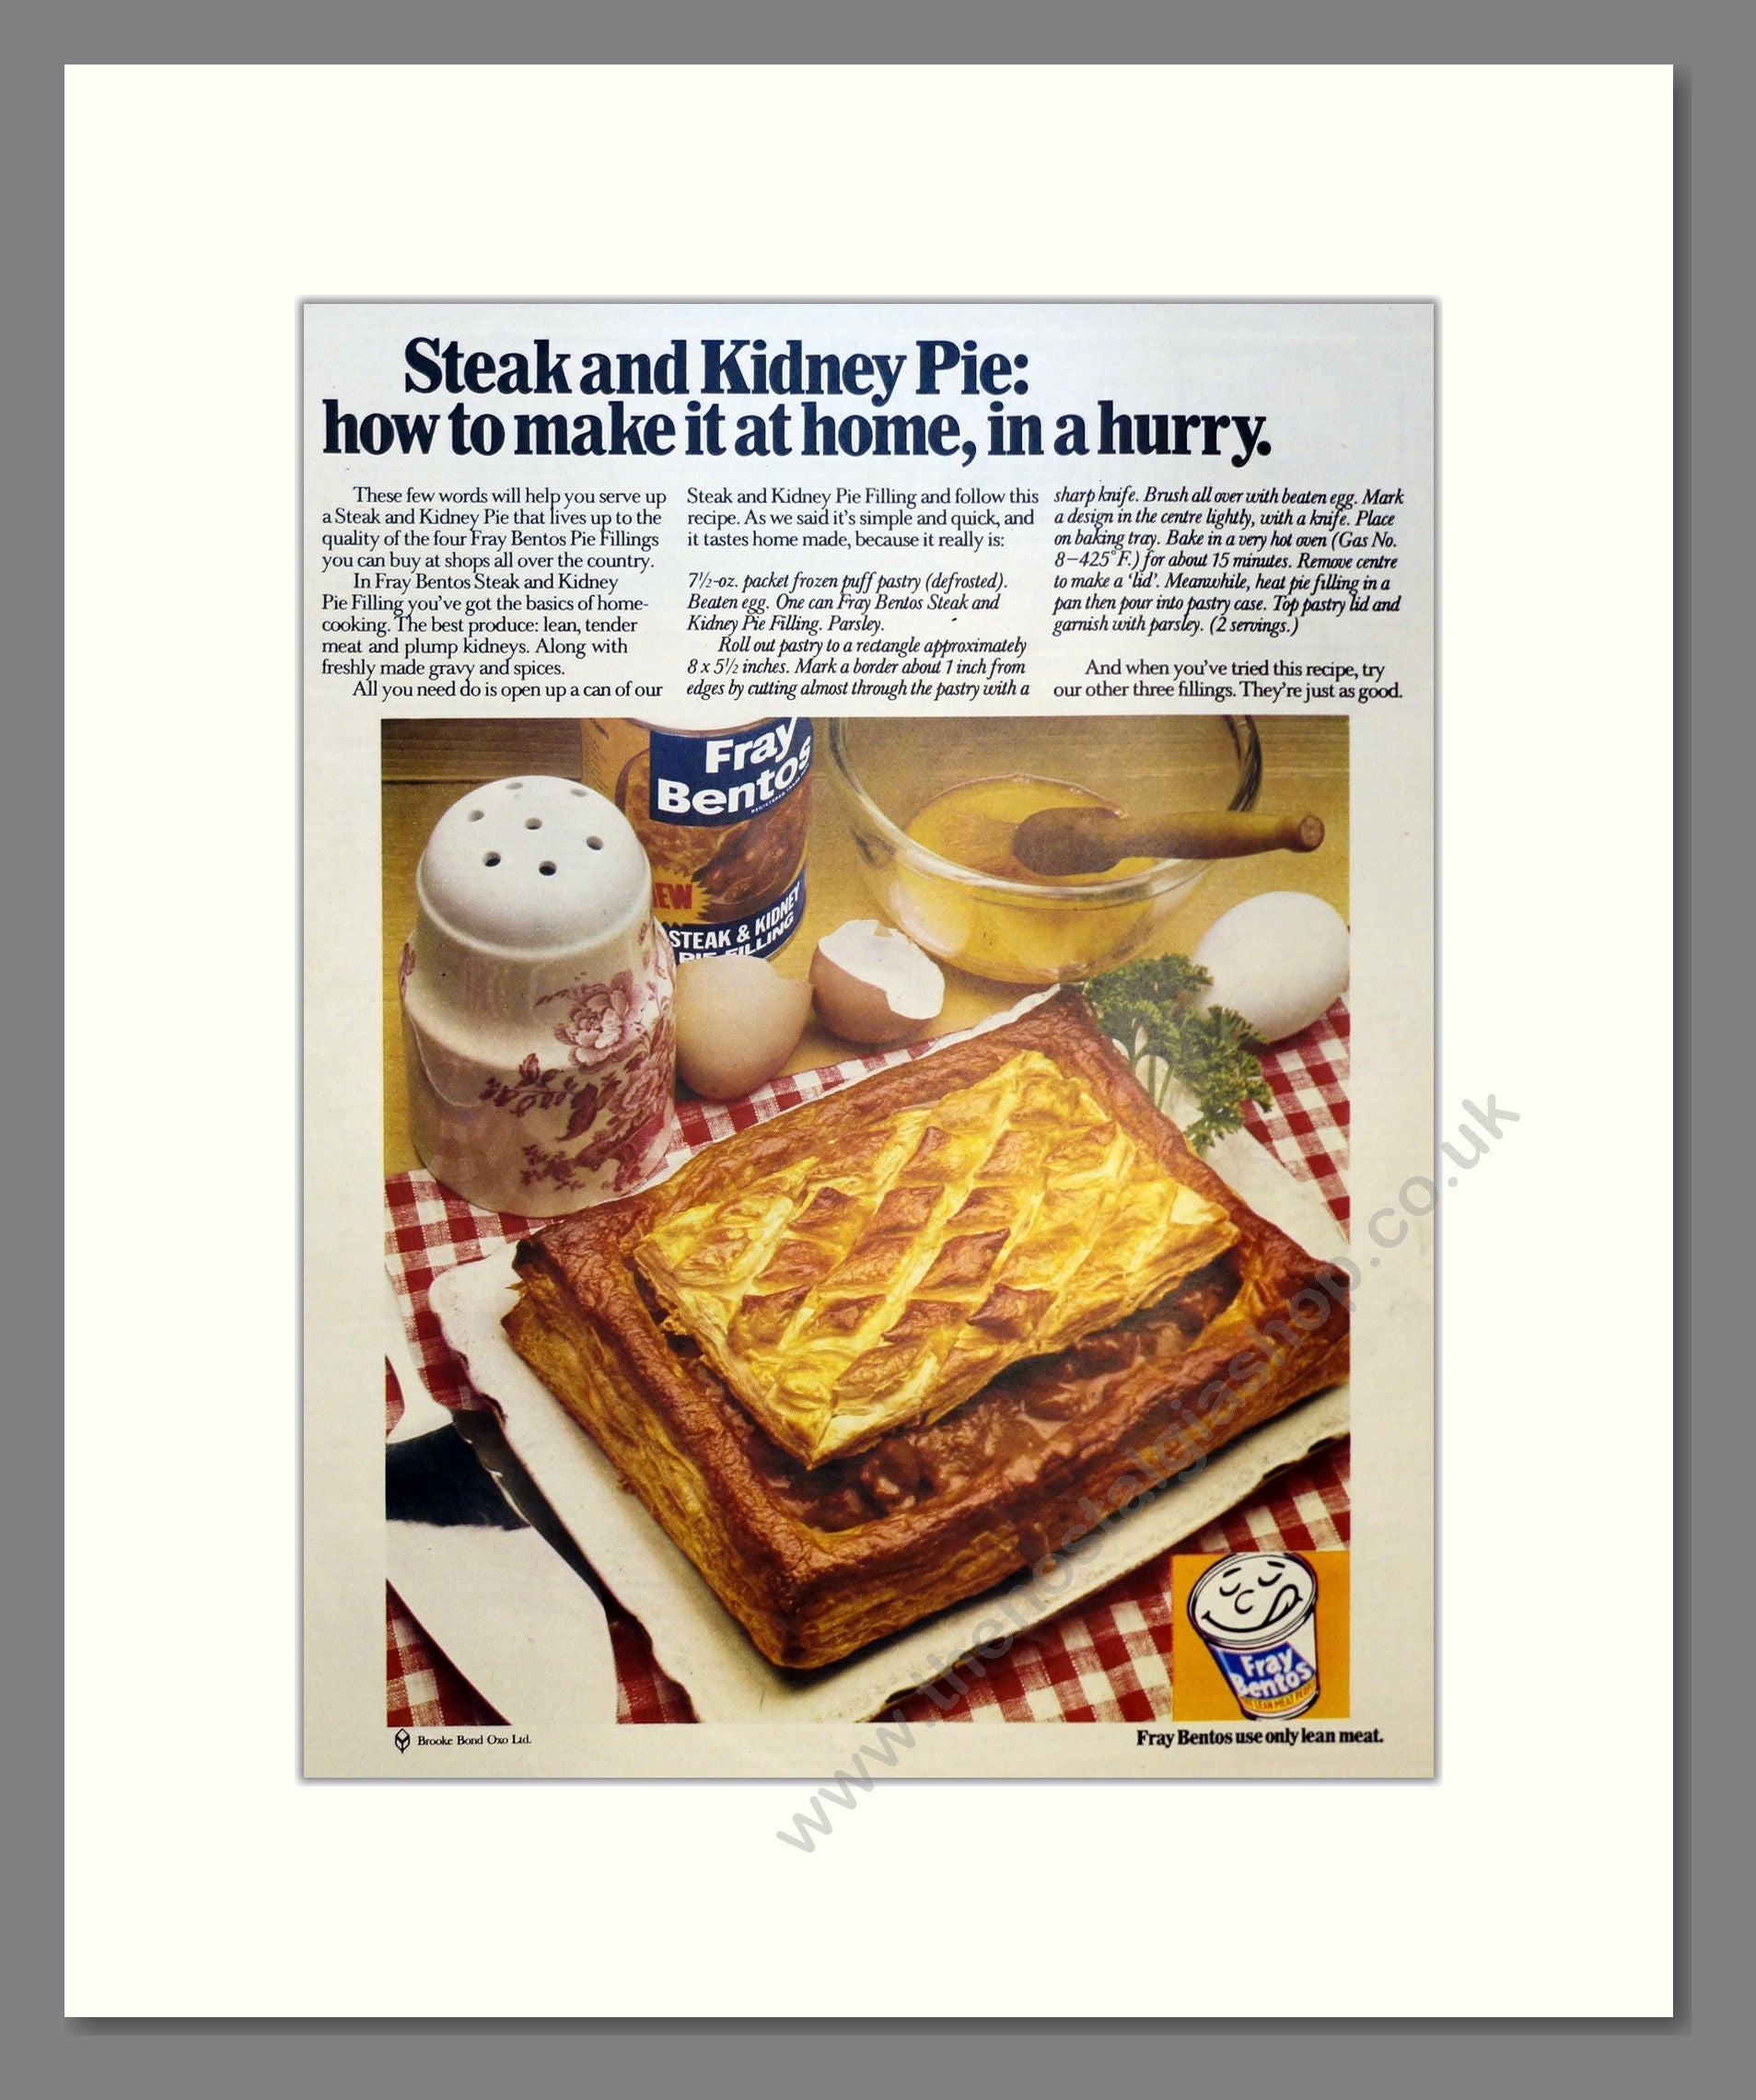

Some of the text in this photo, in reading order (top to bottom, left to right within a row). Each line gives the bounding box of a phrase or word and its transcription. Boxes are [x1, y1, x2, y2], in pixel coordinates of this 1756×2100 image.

[405, 336, 1029, 407] Steak and Kidney Pie:
[323, 399, 1272, 468] how to make it at home, in a hurry.
[354, 486, 667, 508] These few words will help you serve up
[687, 486, 1039, 508] Steak and Kidney Pie Filling and follow this
[322, 508, 661, 530] a Steak and Kidney Pie that lives up to the
[688, 508, 739, 530] recipe.
[744, 508, 766, 525] As
[770, 512, 793, 525] we
[797, 508, 830, 525] said
[860, 508, 913, 531] simple
[917, 508, 947, 525] and
[951, 508, 1000, 531] quick,
[1005, 508, 1034, 525] and
[1053, 508, 1395, 531] a design in the centre lightly, with a knife. Place
[322, 529, 658, 552] quality of the four Fray Bentos Pie Fillings
[688, 530, 1004, 552] it tastes home made, because it really is:
[322, 551, 654, 573] you can buy at shops all over the country.
[687, 592, 1002, 614] Beaten egg. One can Fray Bentos Steak and
[1052, 593, 1402, 616] pan then pour into pastry case. Top pastry lid and
[687, 614, 885, 636] Kidney Pie Filling. Parsley.
[321, 636, 627, 659] meat and plump kidneys. Along with
[1085, 659, 1122, 675] And
[1125, 659, 1169, 675] when
[1231, 659, 1270, 675] tried
[1273, 659, 1302, 675] this
[1306, 659, 1358, 681] recipe,
[1362, 659, 1385, 681] try
[1053, 684, 1082, 697] our
[1086, 680, 1129, 697] other
[1133, 680, 1174, 697] three
[1178, 681, 1236, 703] fillings.
[1306, 681, 1335, 703] just
[1339, 684, 1355, 697] as
[1358, 681, 1402, 703] good.
[705, 717, 797, 773] Fray
[657, 736, 811, 815] Bentos
[653, 881, 692, 909] EW
[669, 881, 800, 950] STEAK & KIDNEY
[1240, 1648, 1293, 1676] Fray
[1229, 1662, 1312, 1698] Bentos
[418, 1733, 531, 1745] Brooke Bond Oxo Ltd.
[1136, 1727, 1383, 1748] Fray Bentos use only lean meat.
